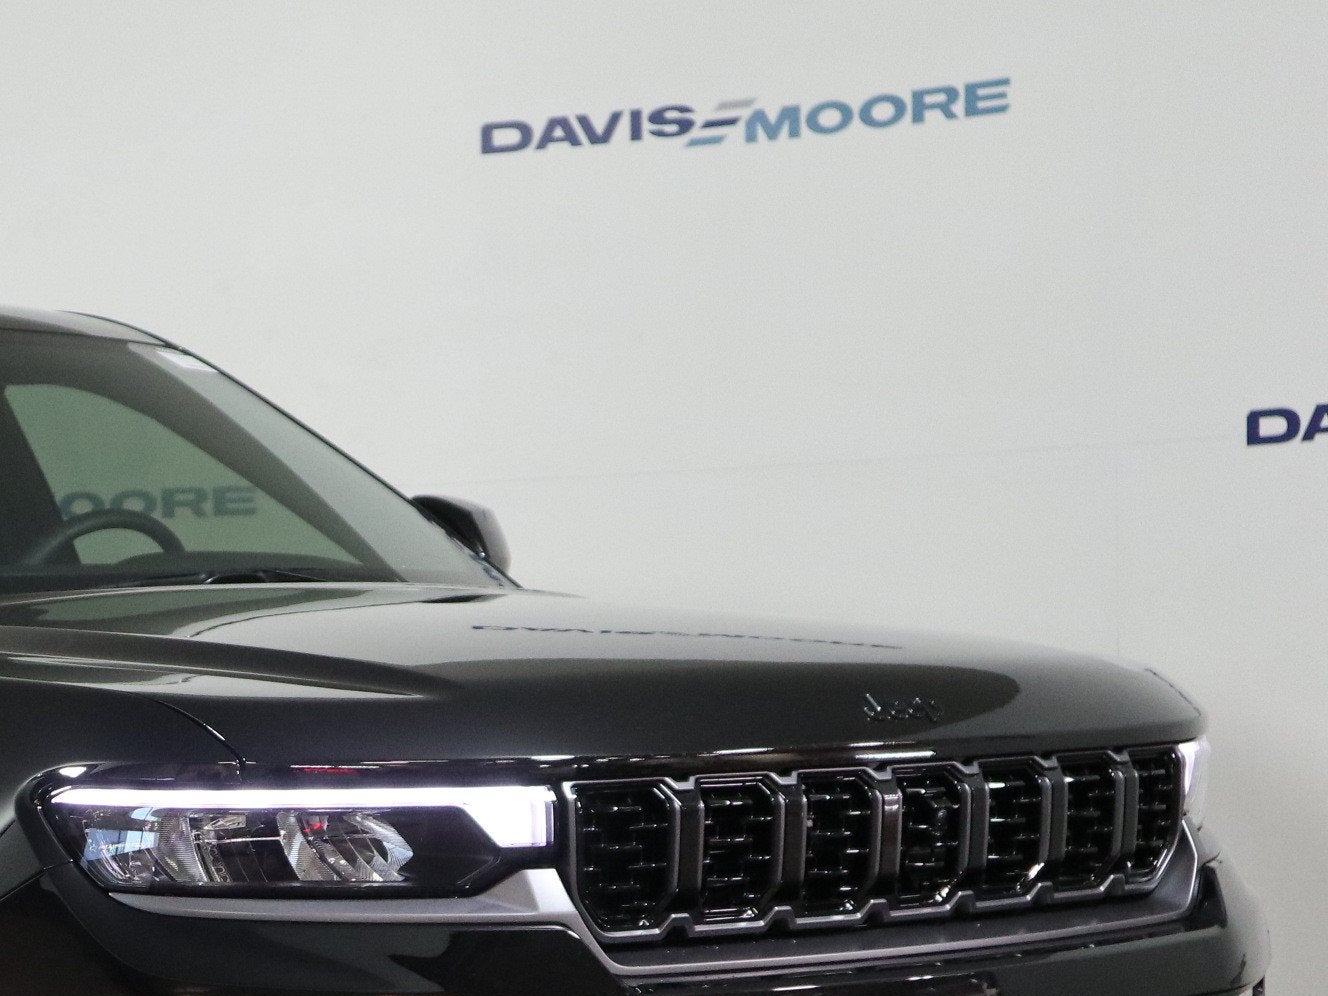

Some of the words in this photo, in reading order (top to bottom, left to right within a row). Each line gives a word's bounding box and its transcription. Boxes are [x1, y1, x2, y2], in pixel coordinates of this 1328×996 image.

[480, 105, 696, 154] DAVIS
[744, 78, 1011, 143] MOORE
[59, 486, 258, 518] OORE
